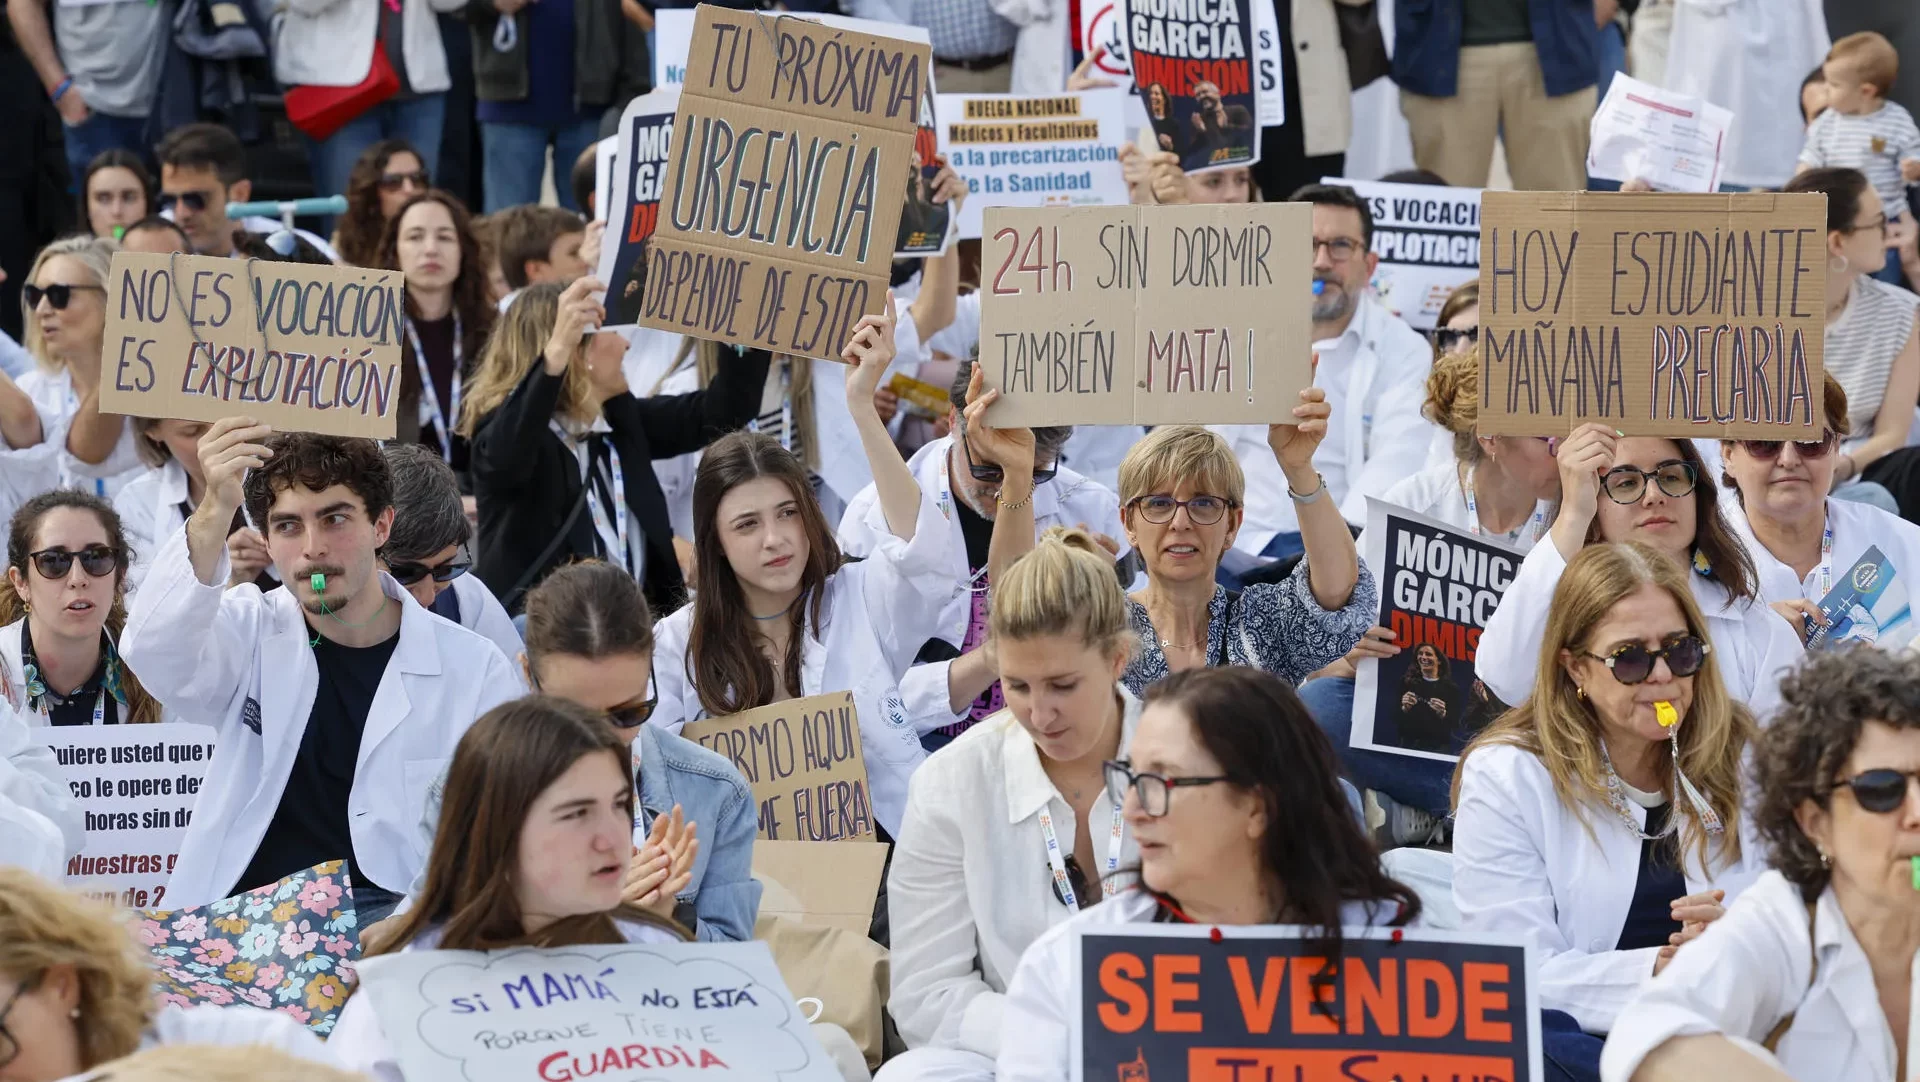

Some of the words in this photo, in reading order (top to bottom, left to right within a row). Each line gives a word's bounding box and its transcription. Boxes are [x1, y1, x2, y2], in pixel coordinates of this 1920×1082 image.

[1131, 14, 1246, 59] GARCÍA
[709, 23, 753, 93] TU
[771, 32, 920, 123] PRÓXIMA
[967, 100, 1013, 117] HUELGA
[1017, 97, 1077, 115] NACIONAL
[1007, 127, 1014, 143] y
[1017, 121, 1098, 140] Facultativos
[968, 148, 985, 166] la
[994, 144, 1118, 168] precarización
[670, 113, 881, 264] URGENCIA
[961, 173, 980, 194] e
[985, 174, 1004, 194] la
[1009, 171, 1091, 193] Sanidad
[1368, 197, 1386, 221] S
[1393, 198, 1480, 226] VOCACI
[992, 225, 1073, 297] 24h
[1096, 219, 1149, 290] SIN
[1172, 219, 1273, 288] DORMIR
[1370, 230, 1480, 265] PLOTACI
[1491, 226, 1580, 315] HOY
[1610, 226, 1817, 318] ESTUDIANTE
[119, 268, 170, 324] NO
[189, 270, 234, 328] ES
[254, 275, 405, 347] VOCACIÓN
[644, 248, 751, 337] DEPENDE
[753, 266, 792, 346] DE
[791, 273, 869, 357] ESTO
[115, 336, 157, 393] ES
[181, 340, 398, 419] EXPLOTACIÓN
[994, 318, 1115, 395] TAMBIÉN
[1145, 327, 1233, 394] MATA
[1484, 319, 1625, 419] MAÑANA
[1650, 322, 1815, 427] PRECARIA
[1395, 528, 1523, 593] MÓNIC
[48, 744, 107, 766] uiere
[111, 742, 164, 764] usted
[168, 744, 203, 764] que
[95, 776, 113, 798] le
[117, 777, 172, 799] opere
[793, 777, 873, 842] FUERA
[85, 810, 139, 831] horas
[142, 808, 170, 829] sin
[67, 853, 162, 876] Nuestras
[502, 967, 621, 1010] MAMÁ
[693, 983, 759, 1011] ESTÁ
[1097, 952, 1203, 1034] SE
[1226, 956, 1513, 1042] VENDE
[474, 1022, 599, 1051] PORQUE
[537, 1043, 731, 1082] GUARDIA
